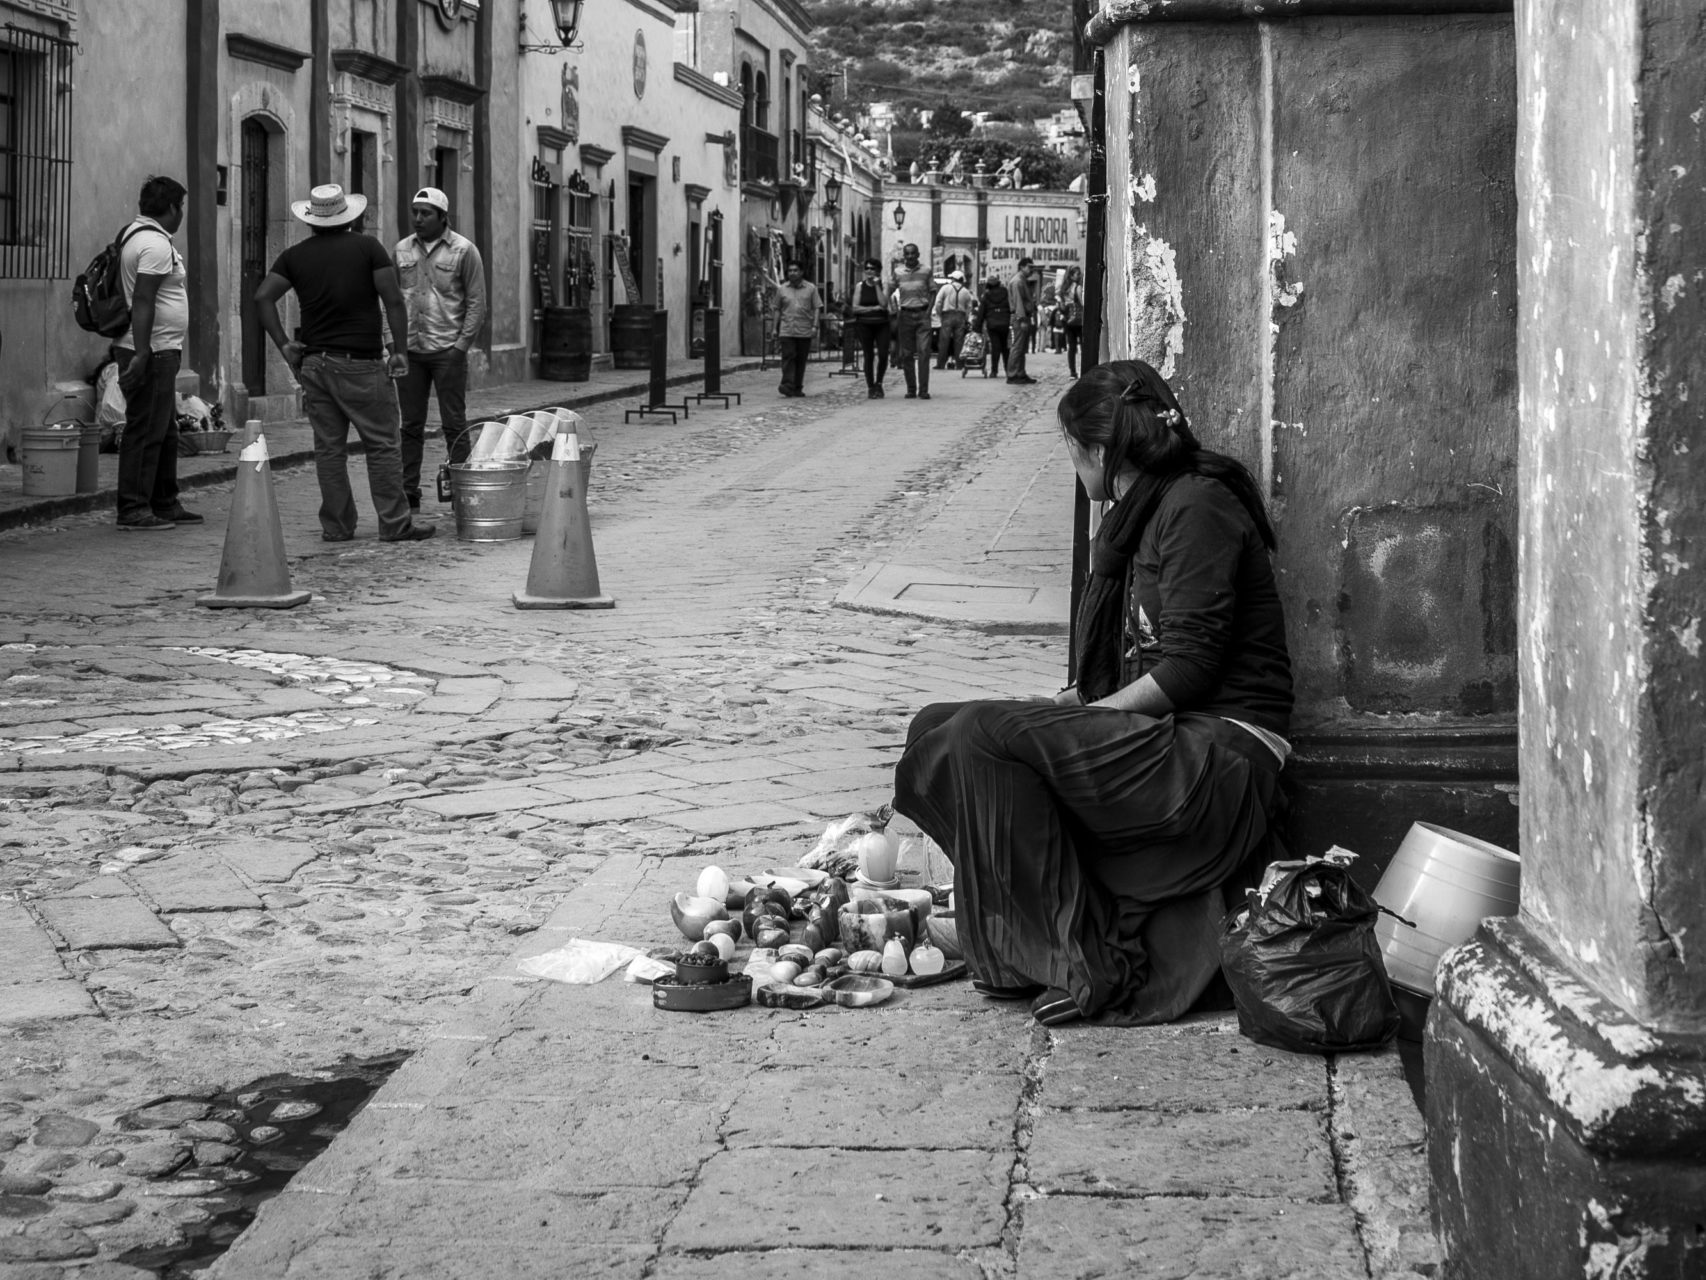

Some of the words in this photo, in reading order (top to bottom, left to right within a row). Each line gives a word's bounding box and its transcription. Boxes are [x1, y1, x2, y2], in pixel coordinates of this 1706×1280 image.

[1022, 216, 1068, 244] AURORA
[992, 247, 1026, 260] CENTRO
[1032, 248, 1080, 261] ARTESANAL
